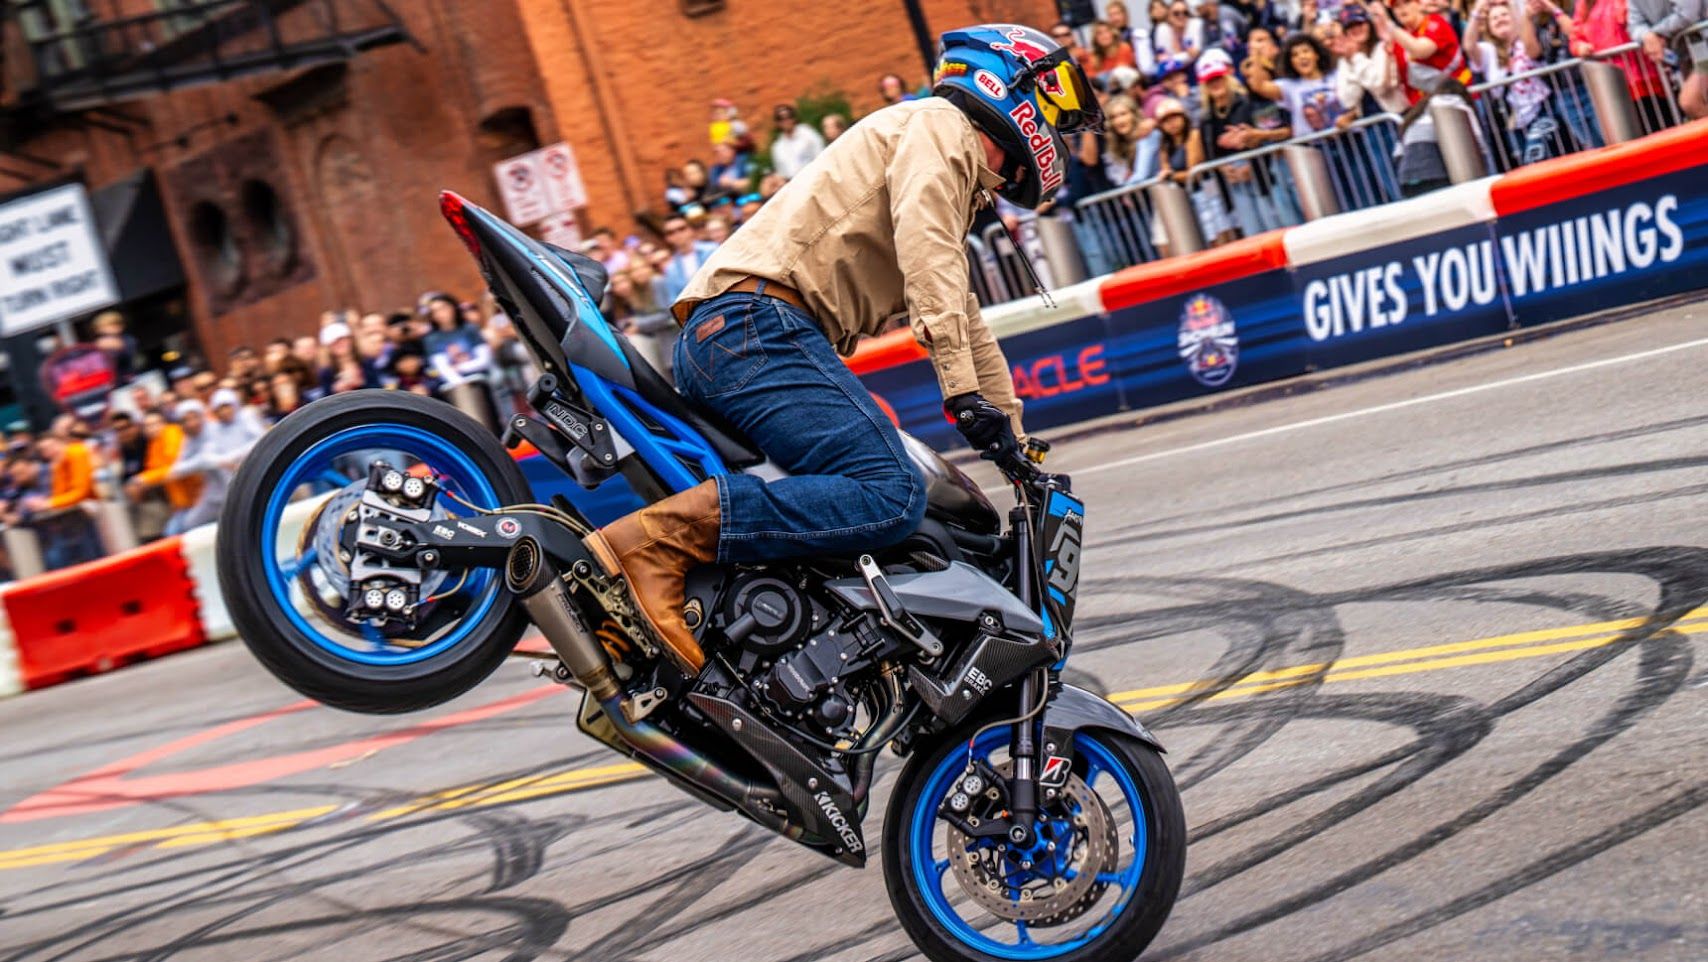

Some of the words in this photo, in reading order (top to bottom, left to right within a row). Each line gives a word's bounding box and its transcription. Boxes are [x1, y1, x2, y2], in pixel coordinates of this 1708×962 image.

[978, 73, 1003, 97] BELL
[1304, 262, 1408, 341] GIVES
[1413, 240, 1497, 317] YOU
[1501, 194, 1684, 297] WIIINGS
[1012, 344, 1111, 399] ACLE
[967, 666, 993, 690] EBC
